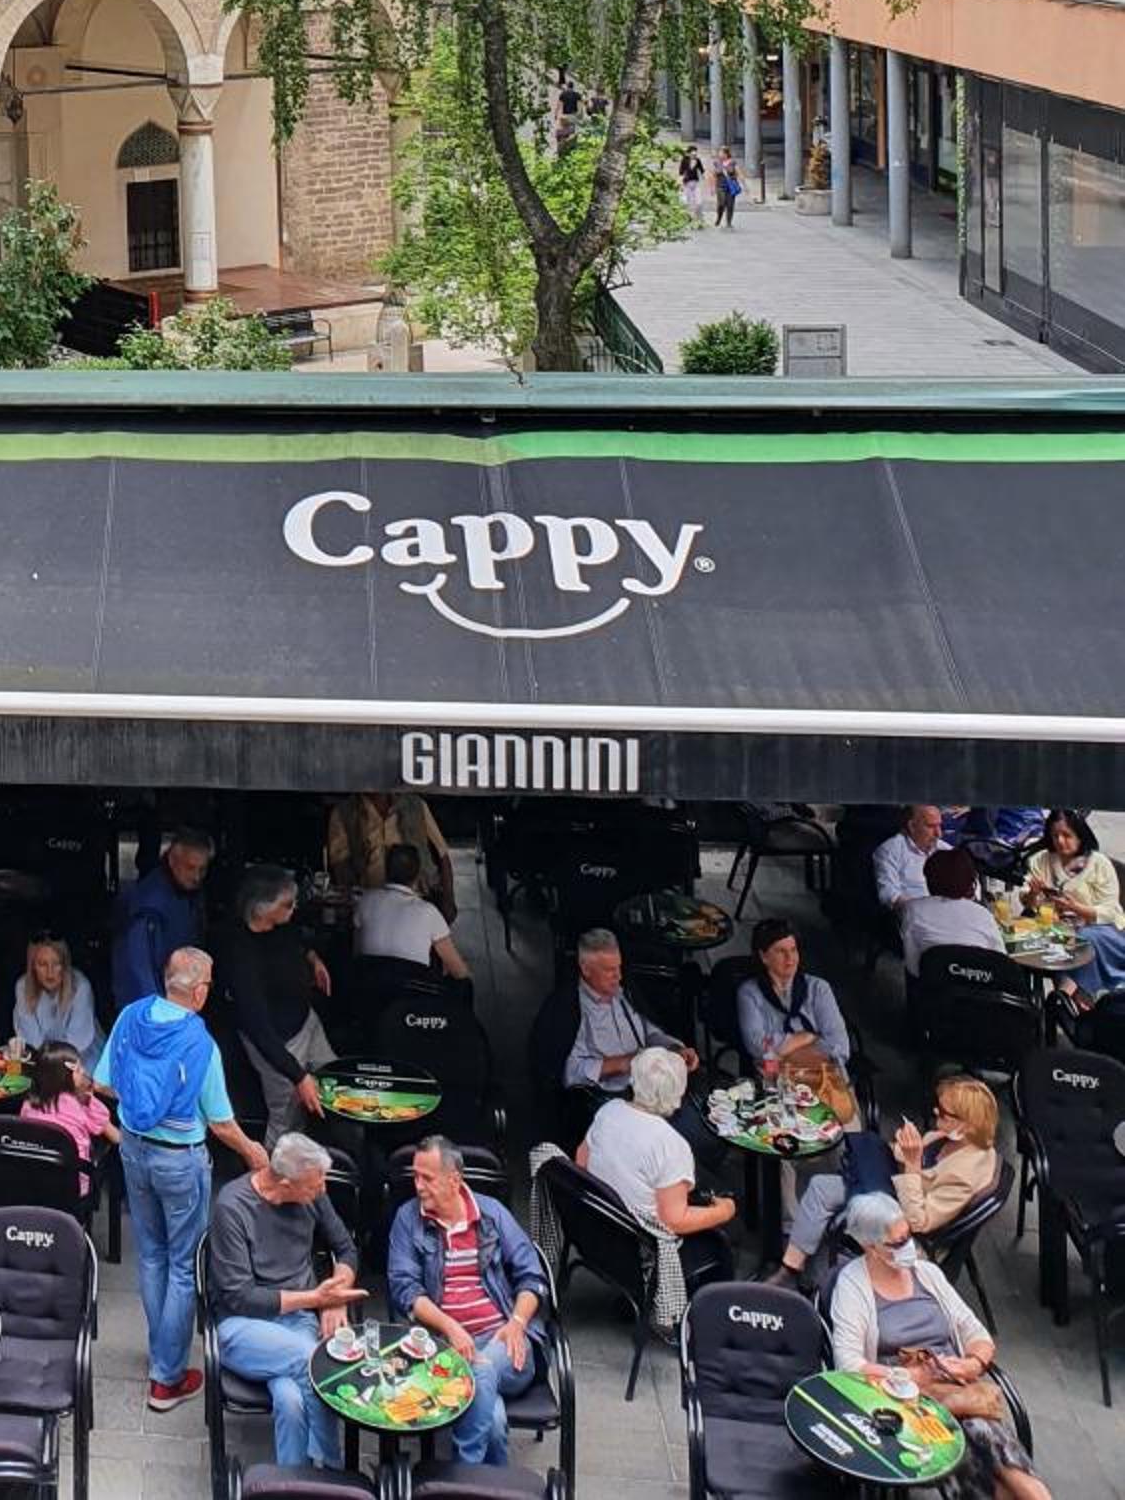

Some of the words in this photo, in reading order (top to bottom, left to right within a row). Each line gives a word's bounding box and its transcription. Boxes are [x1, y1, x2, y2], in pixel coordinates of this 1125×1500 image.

[283, 491, 704, 595] Cappy
[401, 732, 639, 792] GIANNINI
[948, 963, 993, 983] Cappy
[405, 1013, 448, 1029] Cappy
[1052, 1069, 1100, 1088] Cappy
[6, 1226, 54, 1247] Cappy
[728, 1305, 783, 1331] Cappy
